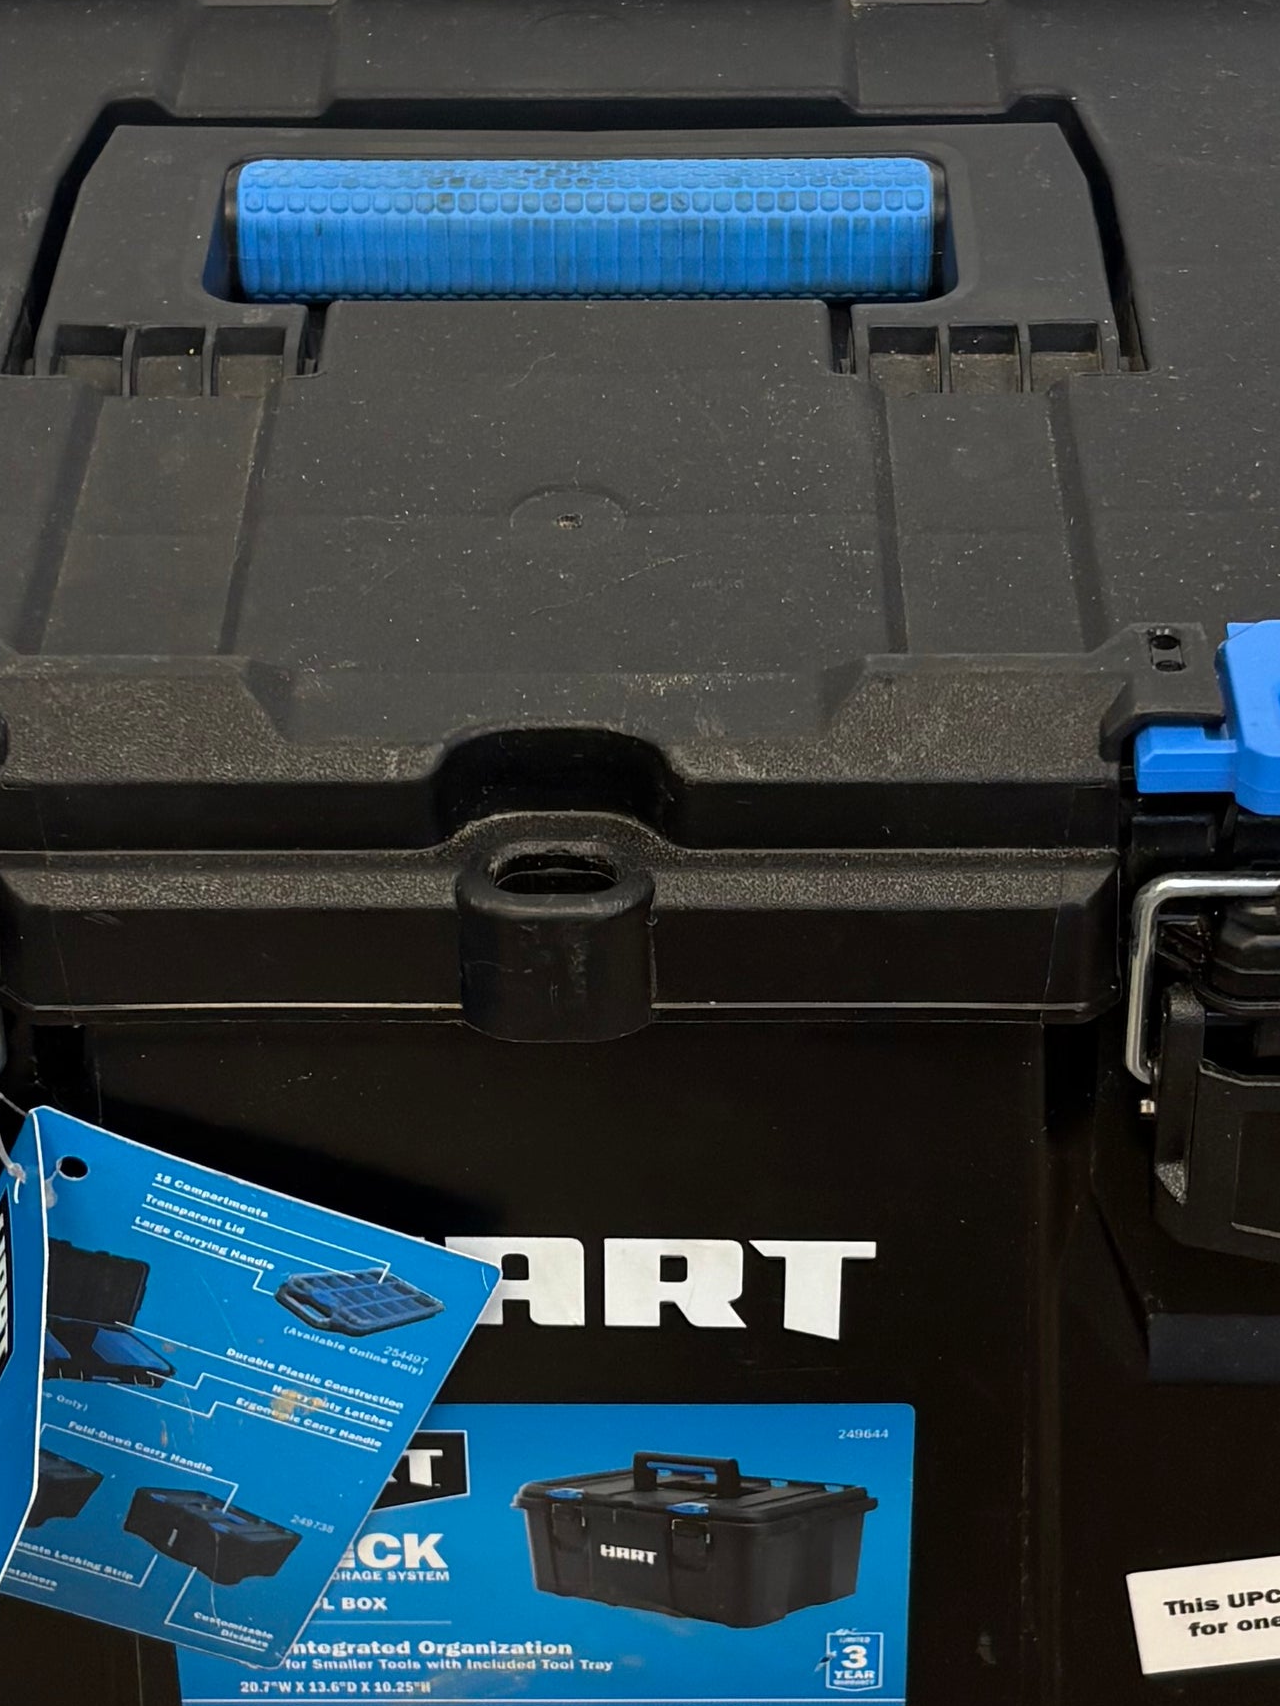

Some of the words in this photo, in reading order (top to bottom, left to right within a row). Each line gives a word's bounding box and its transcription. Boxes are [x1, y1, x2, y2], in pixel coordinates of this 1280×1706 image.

[174, 1180, 269, 1219] Compartments
[145, 1194, 222, 1227] Transparent
[224, 1222, 245, 1235] Lid
[135, 1216, 170, 1235] Large
[174, 1230, 228, 1256] Carrying
[230, 1249, 275, 1270] Handle
[417, 1236, 877, 1340] ART
[283, 1326, 346, 1351] (Available
[348, 1346, 388, 1365] Online
[391, 1360, 424, 1376] Only)
[383, 1346, 429, 1366] 254497
[226, 1347, 275, 1370] Durable
[277, 1364, 321, 1384] Plastic
[324, 1379, 404, 1410] Construction
[344, 1406, 393, 1428] Latches
[303, 1419, 336, 1435] Carry
[339, 1429, 382, 1448] Handle
[838, 1428, 889, 1440] 249644
[68, 1420, 132, 1447] Fold-Down
[134, 1443, 168, 1459] Carry
[170, 1453, 213, 1473] Handle
[600, 1543, 657, 1565] HART
[8, 1567, 57, 1587] ntainers
[104, 1565, 134, 1580] Strip
[387, 1570, 449, 1582] SYSTEM
[342, 1597, 388, 1611] BOX
[1163, 1599, 1220, 1616] This
[194, 1611, 274, 1639] Customizable
[1188, 1622, 1228, 1637] for
[221, 1629, 269, 1648] Dividers
[291, 1640, 411, 1657] ntegrated
[418, 1640, 573, 1658] Organization
[841, 1645, 868, 1669] 3
[285, 1658, 307, 1670] for
[312, 1658, 373, 1670] Smaller
[378, 1658, 421, 1670] Tools
[426, 1658, 461, 1670] with
[466, 1658, 536, 1670] Included
[540, 1658, 574, 1670] Tool
[579, 1659, 613, 1672] Tray
[834, 1670, 875, 1679] YEAR
[295, 1681, 305, 1693] X
[361, 1681, 371, 1693] X
